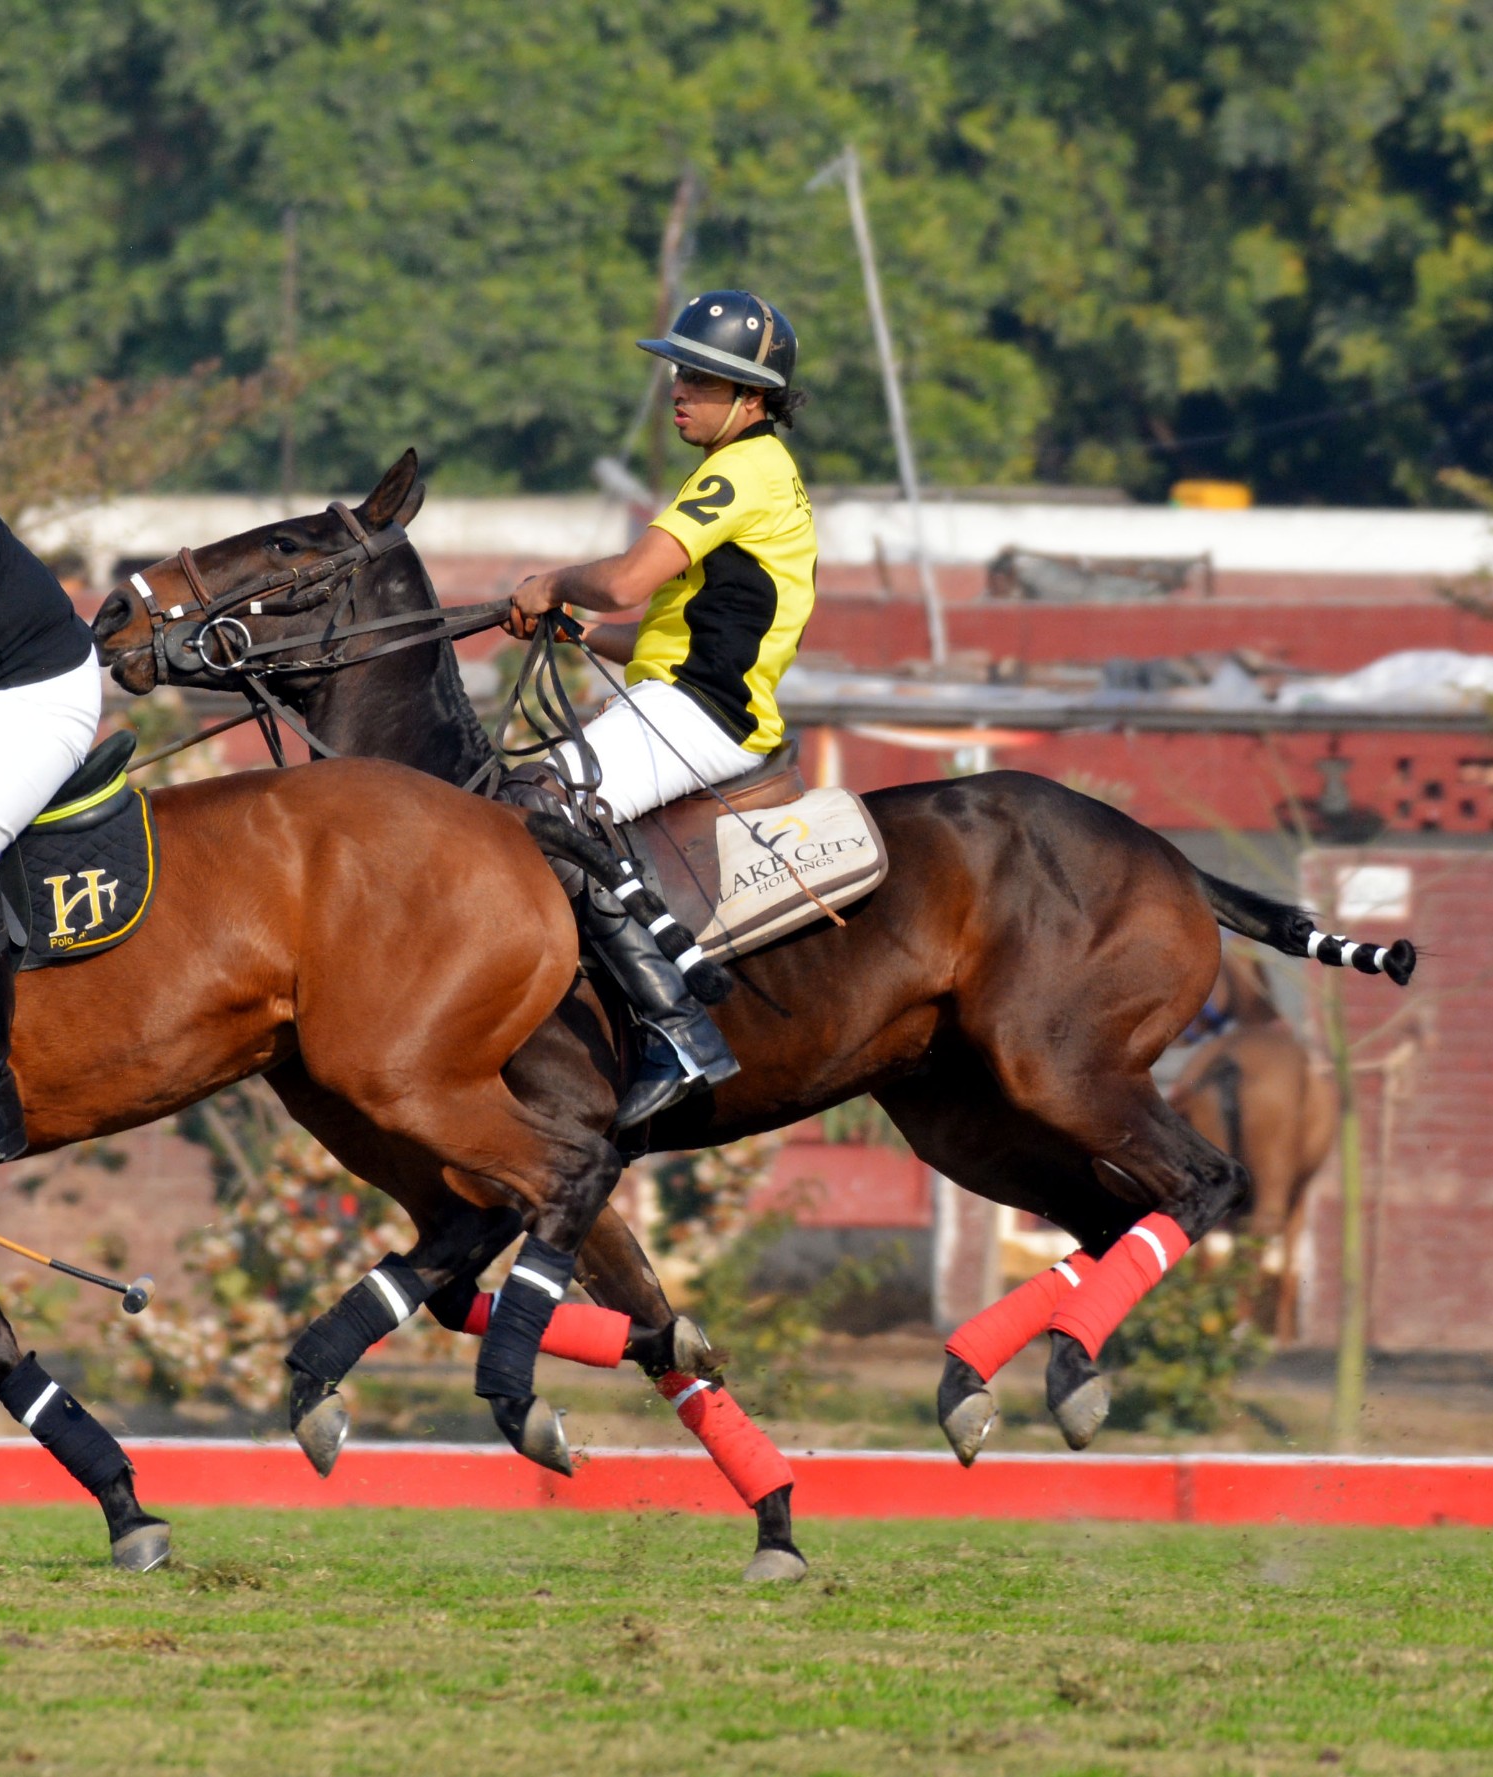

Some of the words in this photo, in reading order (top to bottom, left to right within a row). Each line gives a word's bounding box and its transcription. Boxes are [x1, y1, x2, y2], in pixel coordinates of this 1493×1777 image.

[676, 474, 736, 526] 2
[718, 853, 789, 905] LAKE
[796, 835, 868, 862] CITY
[49, 936, 74, 949] Polo
